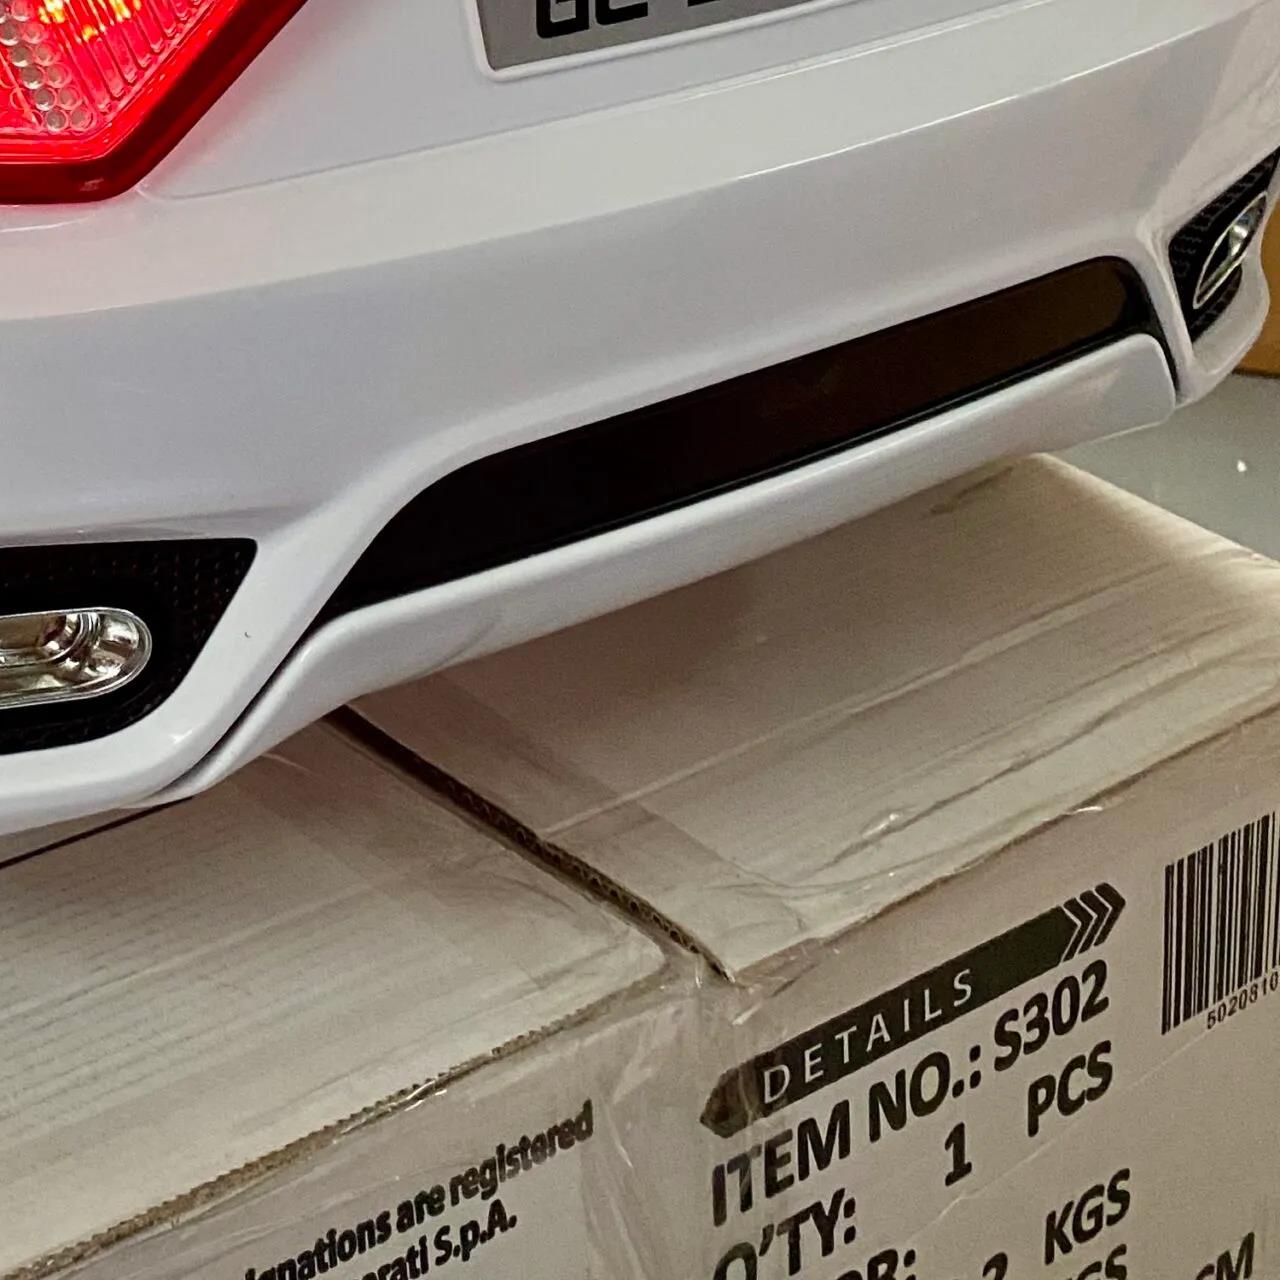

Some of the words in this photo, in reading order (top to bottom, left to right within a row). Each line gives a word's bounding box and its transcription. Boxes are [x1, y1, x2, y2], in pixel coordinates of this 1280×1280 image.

[711, 1098, 851, 1228] ITEM
[868, 1044, 982, 1143] NO.:
[994, 959, 1110, 1072] S302
[763, 968, 972, 1105] DETAILS
[944, 1122, 973, 1187] 1
[1027, 1040, 1113, 1138] PCS
[245, 1210, 392, 1280] nations
[396, 1184, 446, 1234] are
[449, 1098, 594, 1207] registered
[433, 1198, 518, 1266] S.p.A.
[1045, 1167, 1131, 1266] KGS
[1195, 1231, 1256, 1280] M
